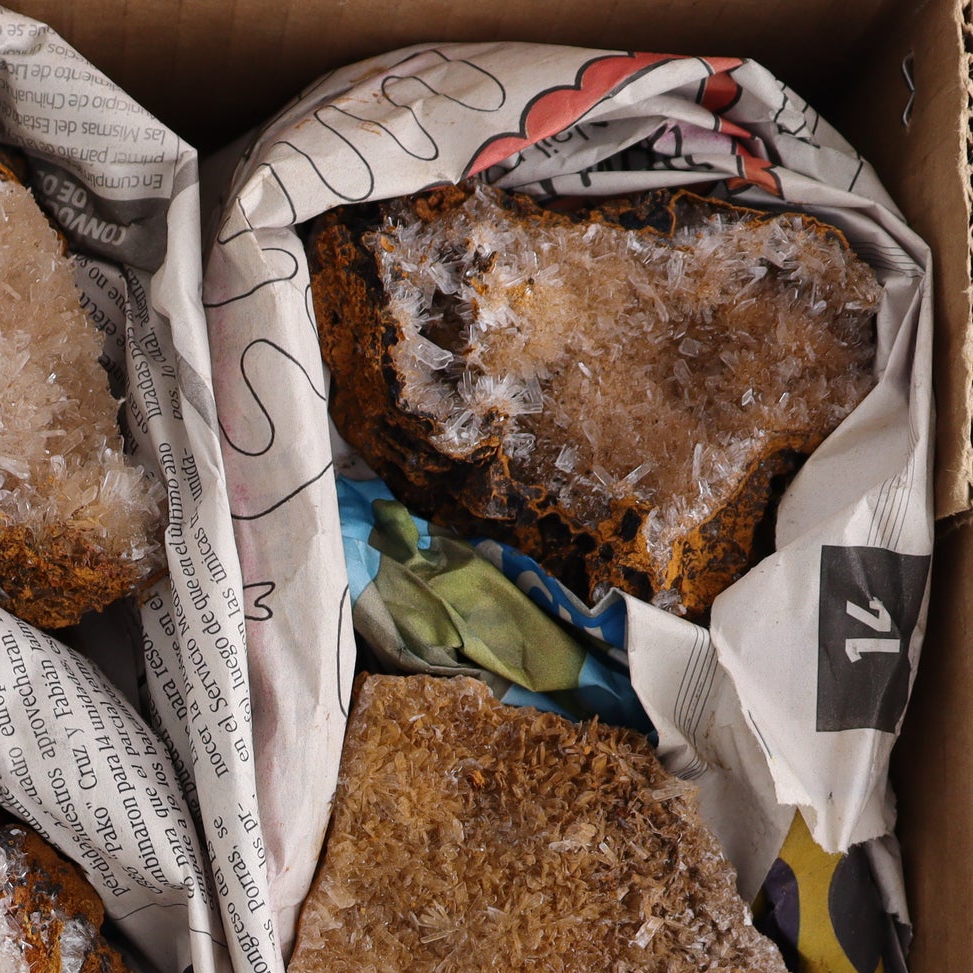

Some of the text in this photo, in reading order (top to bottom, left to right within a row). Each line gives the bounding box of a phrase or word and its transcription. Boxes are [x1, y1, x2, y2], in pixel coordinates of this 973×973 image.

[54, 120, 140, 143] Mismas del
[110, 150, 165, 166] primer
[142, 173, 164, 189] En
[179, 555, 222, 637] de que en
[194, 527, 242, 618] las únicas
[215, 637, 245, 691] luego
[1, 629, 57, 760] aprovecharan.
[162, 678, 187, 721] para
[186, 638, 250, 763] en el Servicio
[41, 659, 97, 790] Cruz Fabián
[197, 725, 230, 778] nocer
[9, 747, 43, 806] cuadro
[96, 735, 136, 794] para 14
[146, 787, 189, 868] para que
[213, 816, 266, 914] Porras, se
